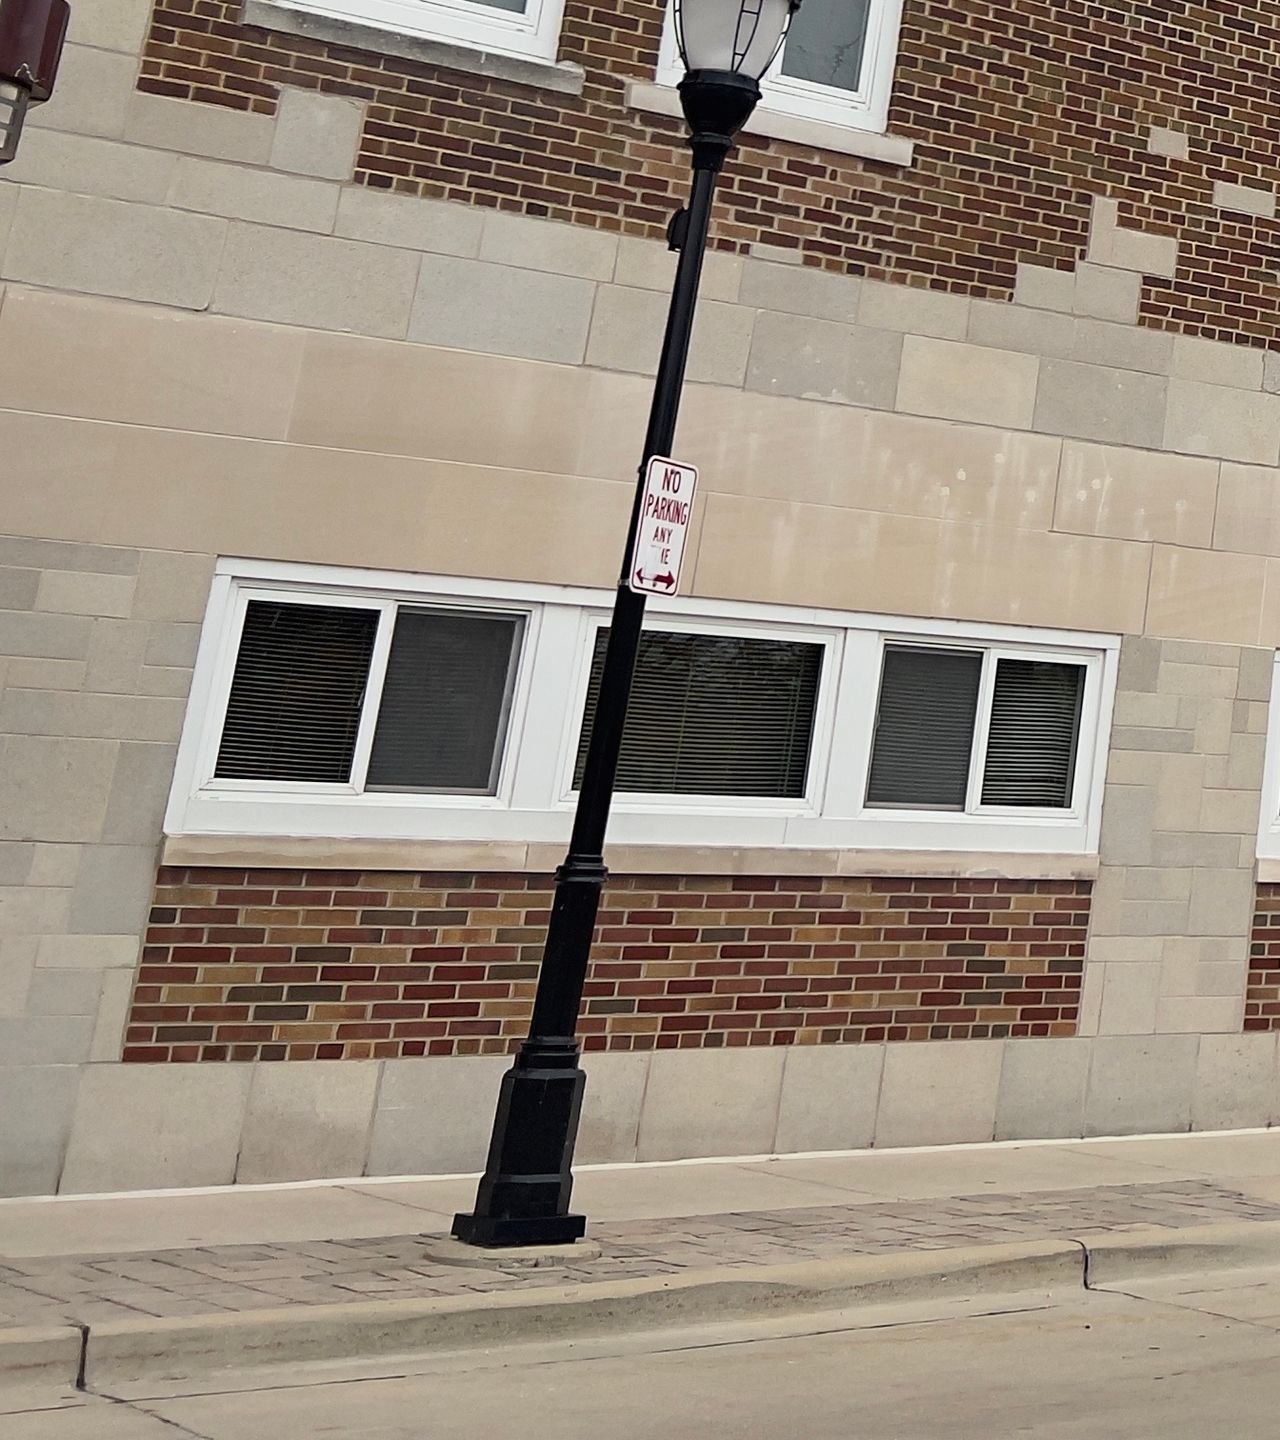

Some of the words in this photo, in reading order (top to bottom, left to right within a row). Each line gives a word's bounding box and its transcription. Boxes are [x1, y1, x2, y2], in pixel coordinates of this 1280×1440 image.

[661, 468, 681, 493] NO
[645, 494, 688, 525] PARKING
[652, 526, 673, 544] ANY
